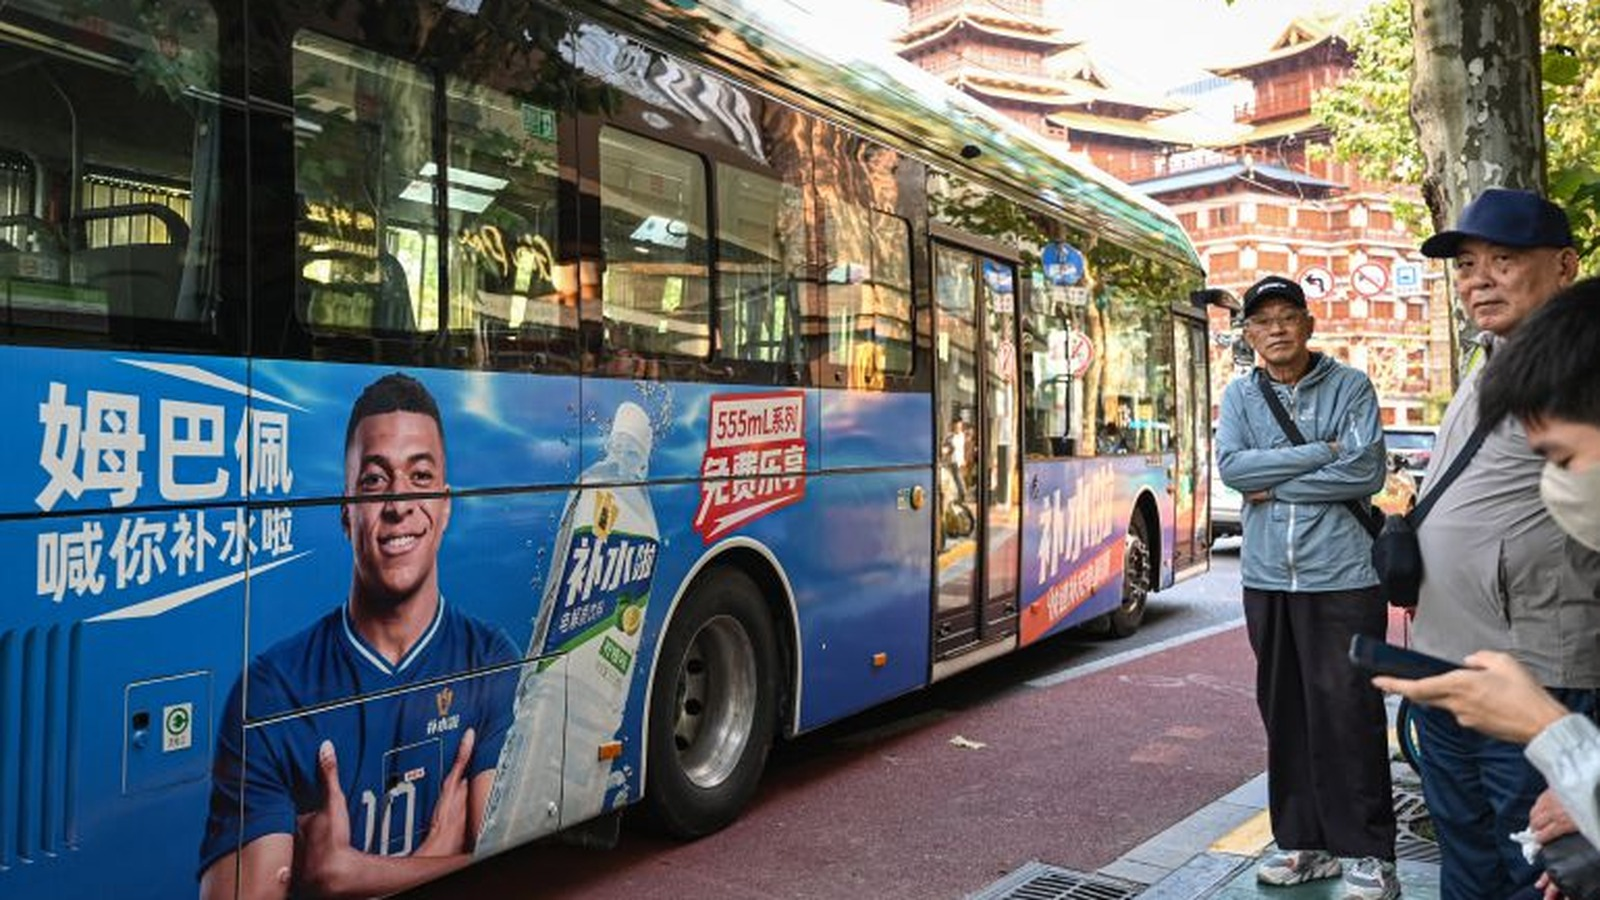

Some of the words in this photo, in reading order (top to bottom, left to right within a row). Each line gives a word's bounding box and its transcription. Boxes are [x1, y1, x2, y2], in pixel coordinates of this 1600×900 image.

[35, 381, 294, 513] 姆巴佩
[716, 405, 799, 440] 555mL系列
[696, 444, 806, 527] 免费乐享
[36, 506, 294, 603] 喊你补水啦
[362, 781, 416, 857] 10
